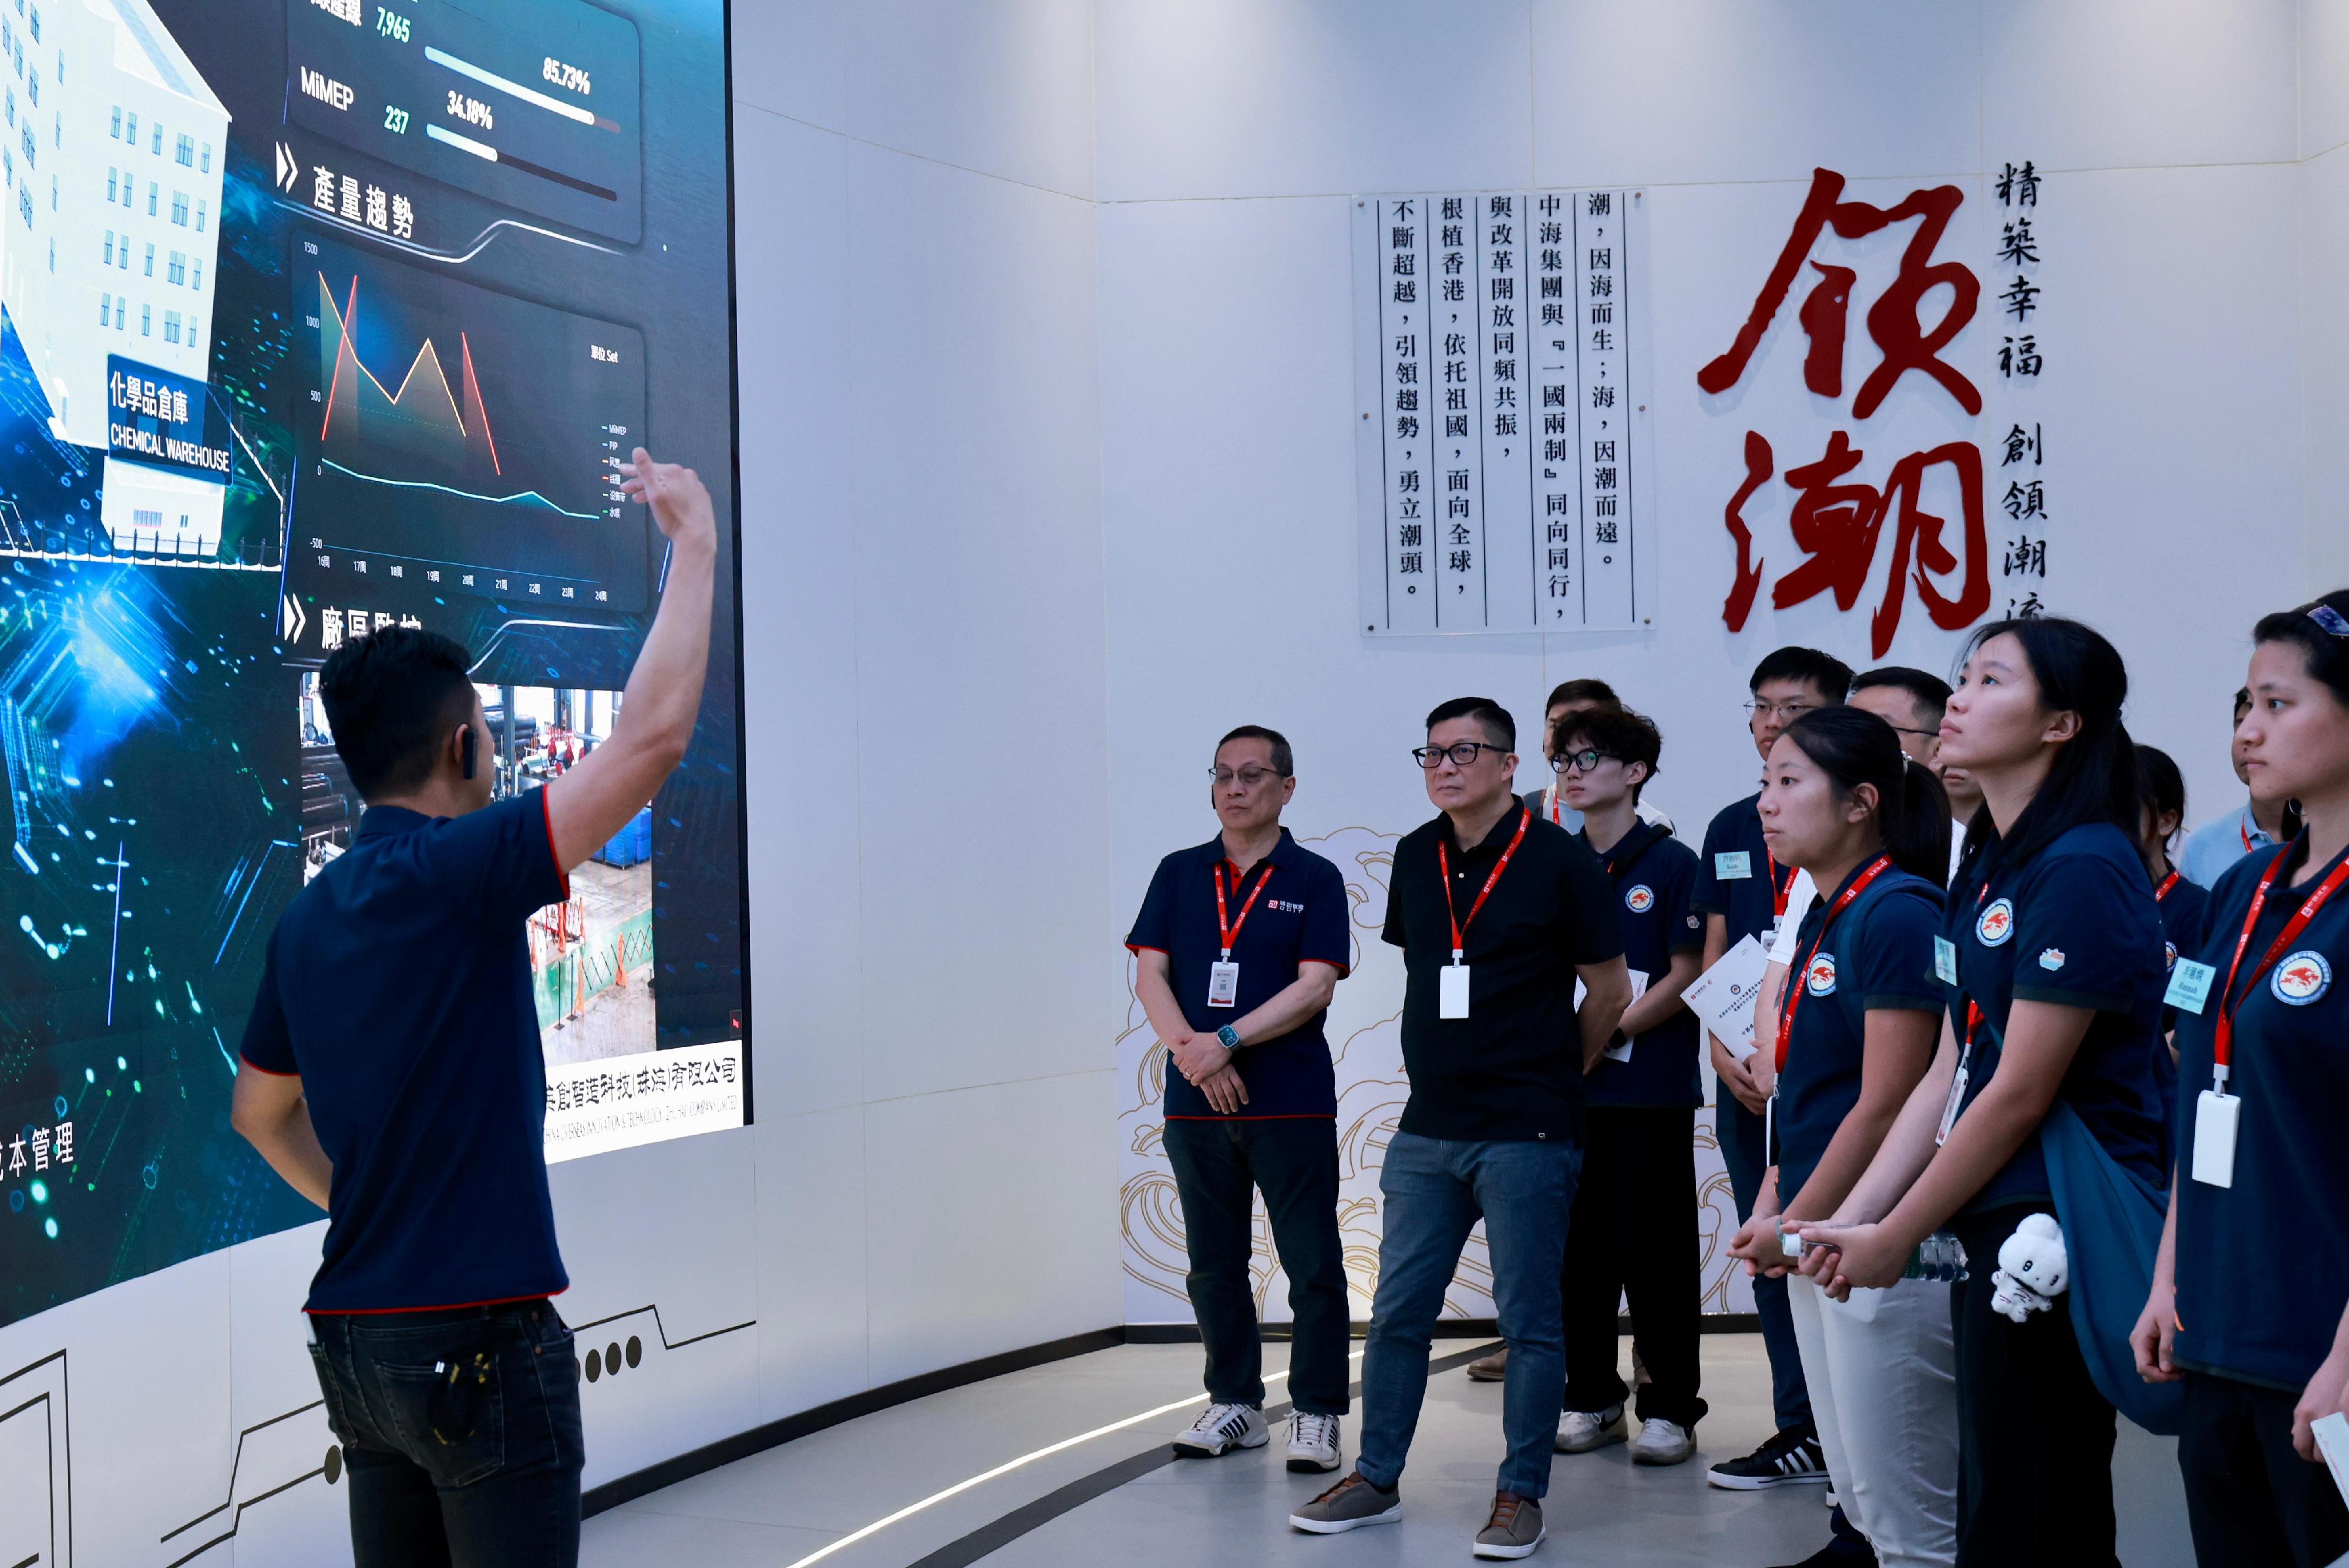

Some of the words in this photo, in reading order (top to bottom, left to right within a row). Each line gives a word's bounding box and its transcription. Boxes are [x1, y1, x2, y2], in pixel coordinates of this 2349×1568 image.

[376, 6, 410, 43] 7,965
[301, 66, 354, 111] MiMEP
[543, 57, 590, 95] 85.73%
[384, 105, 409, 135] 237
[447, 90, 493, 130] 34.18%
[313, 166, 413, 239] 產量趨勢
[303, 241, 318, 257] 1500
[1995, 161, 2042, 378] 精築幸福
[305, 315, 320, 330] 1000
[1490, 196, 1517, 459] 與改革開放同頻共振，
[591, 344, 606, 362] 單位
[607, 349, 618, 363] Set
[110, 371, 189, 425] 化學品倉庫
[310, 390, 321, 403] 500
[1392, 199, 1422, 595] 不斷超越，引領趨勢，勇立潮頭。
[111, 422, 165, 457] CHEMICAL
[166, 437, 230, 472] WAREHOUSE
[608, 424, 627, 436] MiMEP
[609, 440, 618, 451] PIP
[317, 465, 322, 476] 0
[310, 537, 322, 550] -500
[0, 1122, 73, 1182] 本管理
